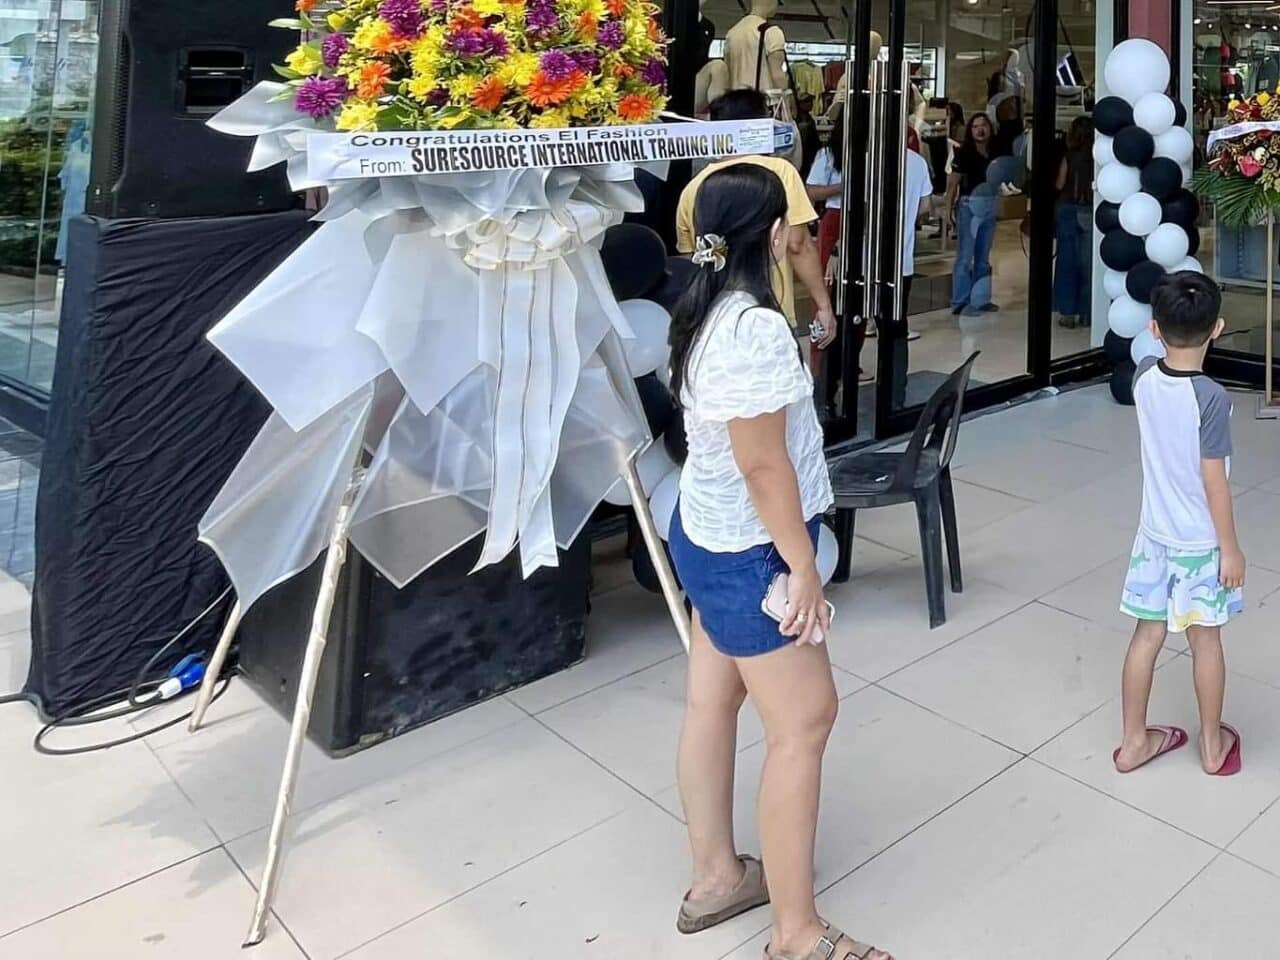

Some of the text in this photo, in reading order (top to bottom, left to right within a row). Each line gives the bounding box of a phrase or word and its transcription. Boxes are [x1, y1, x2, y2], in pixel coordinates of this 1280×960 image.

[351, 132, 550, 148] Congratulations
[587, 127, 668, 140] Fashion
[360, 158, 407, 174] From:
[411, 143, 529, 173] SURESOURCE
[531, 137, 648, 167] INTERNATIONAL
[650, 134, 709, 160] TRADING
[711, 133, 738, 155] INC.
